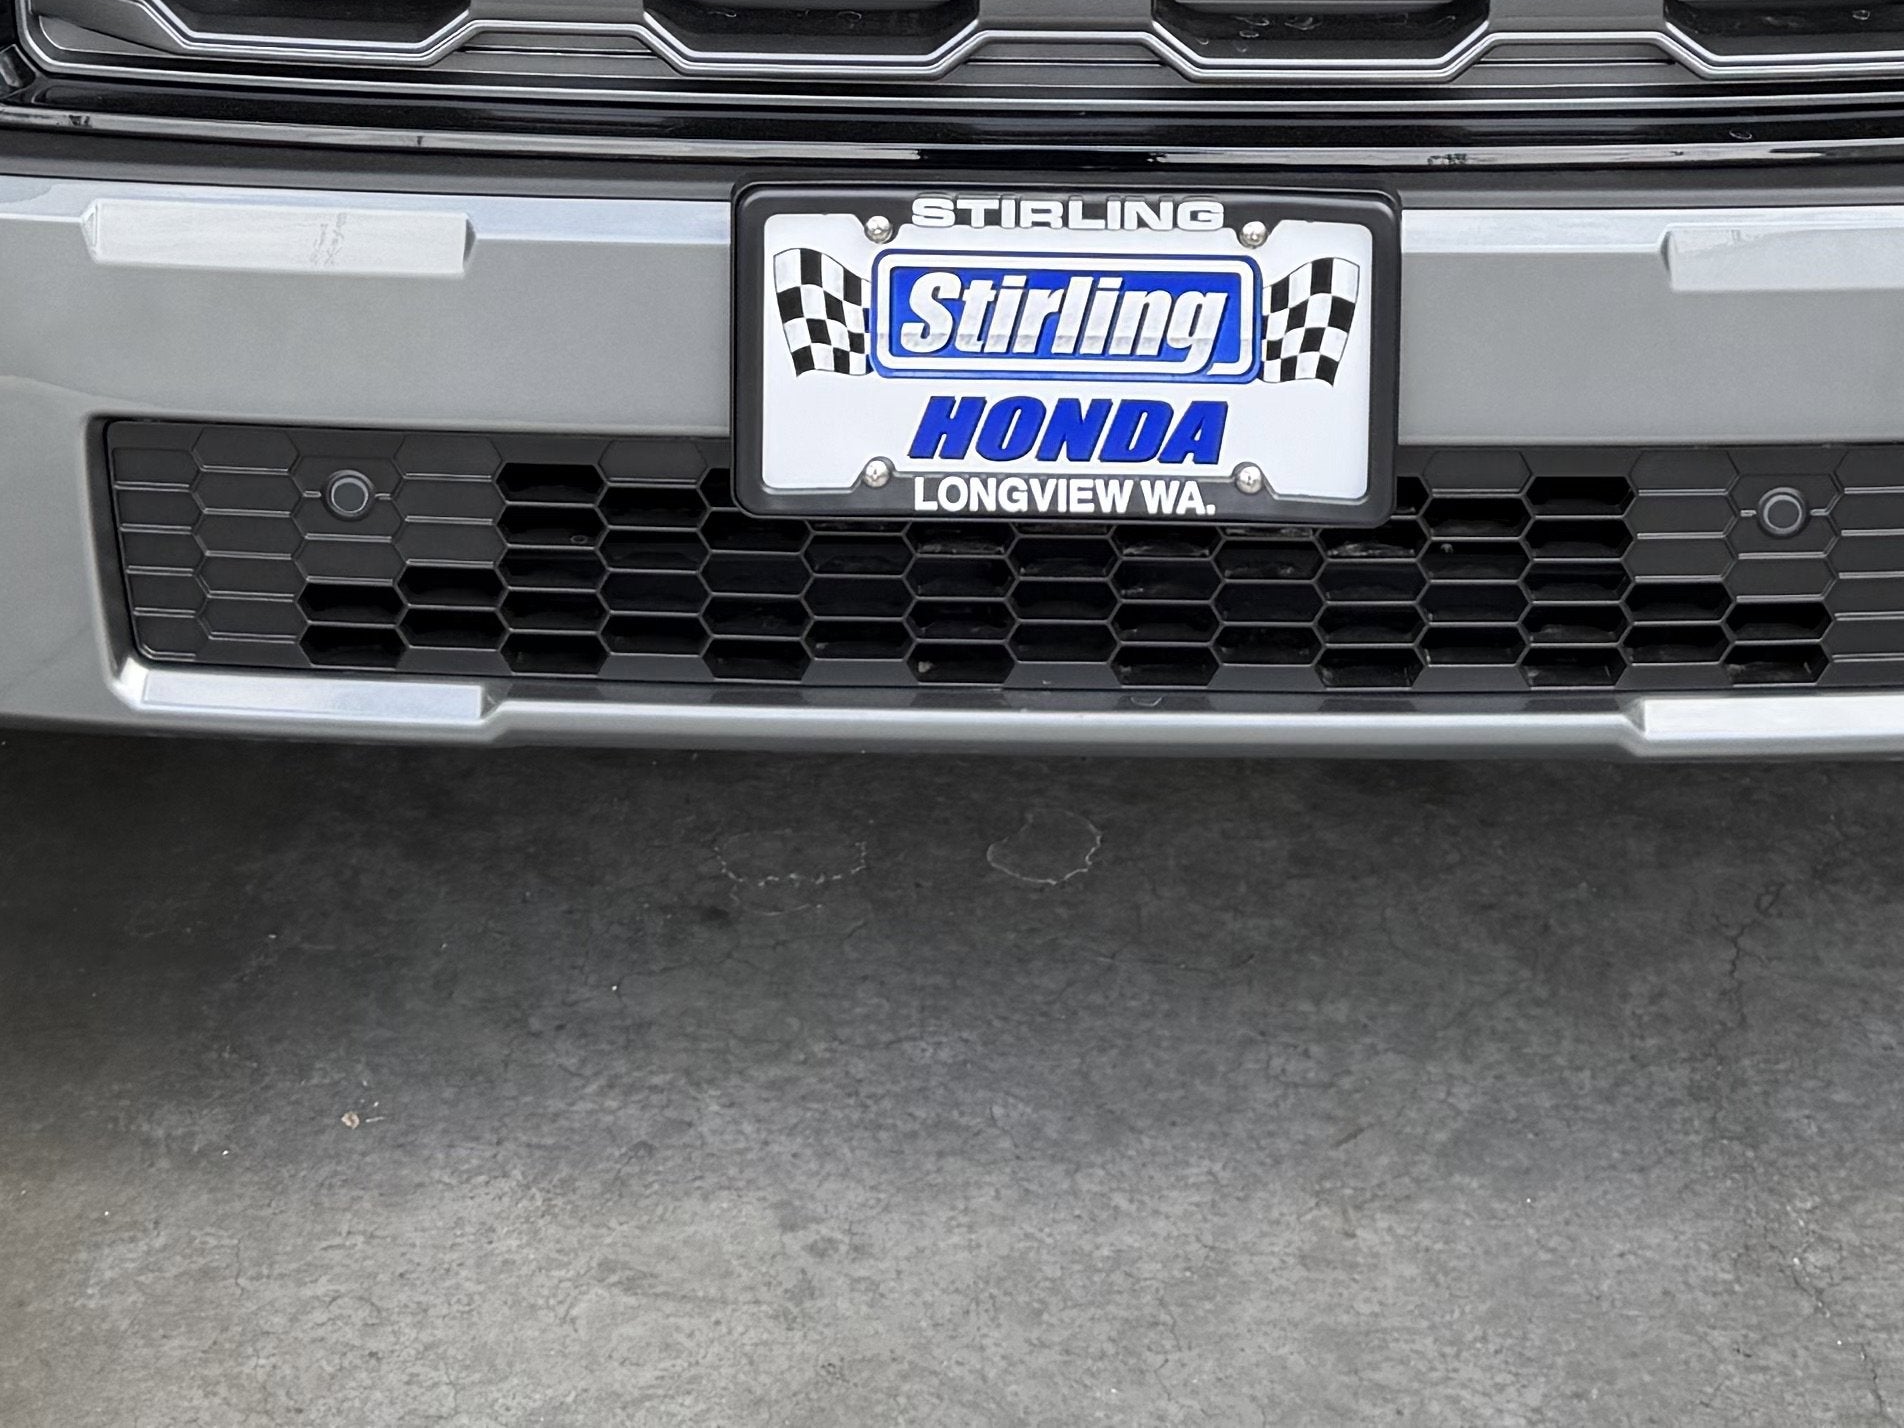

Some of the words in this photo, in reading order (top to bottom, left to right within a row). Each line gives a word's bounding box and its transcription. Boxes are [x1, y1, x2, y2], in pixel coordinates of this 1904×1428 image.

[911, 196, 1225, 231] STIRLING
[900, 271, 1228, 372] Stirling
[907, 395, 1229, 465] HONDA
[914, 475, 1134, 514] LONGVIEW
[1139, 479, 1217, 515] WA.
